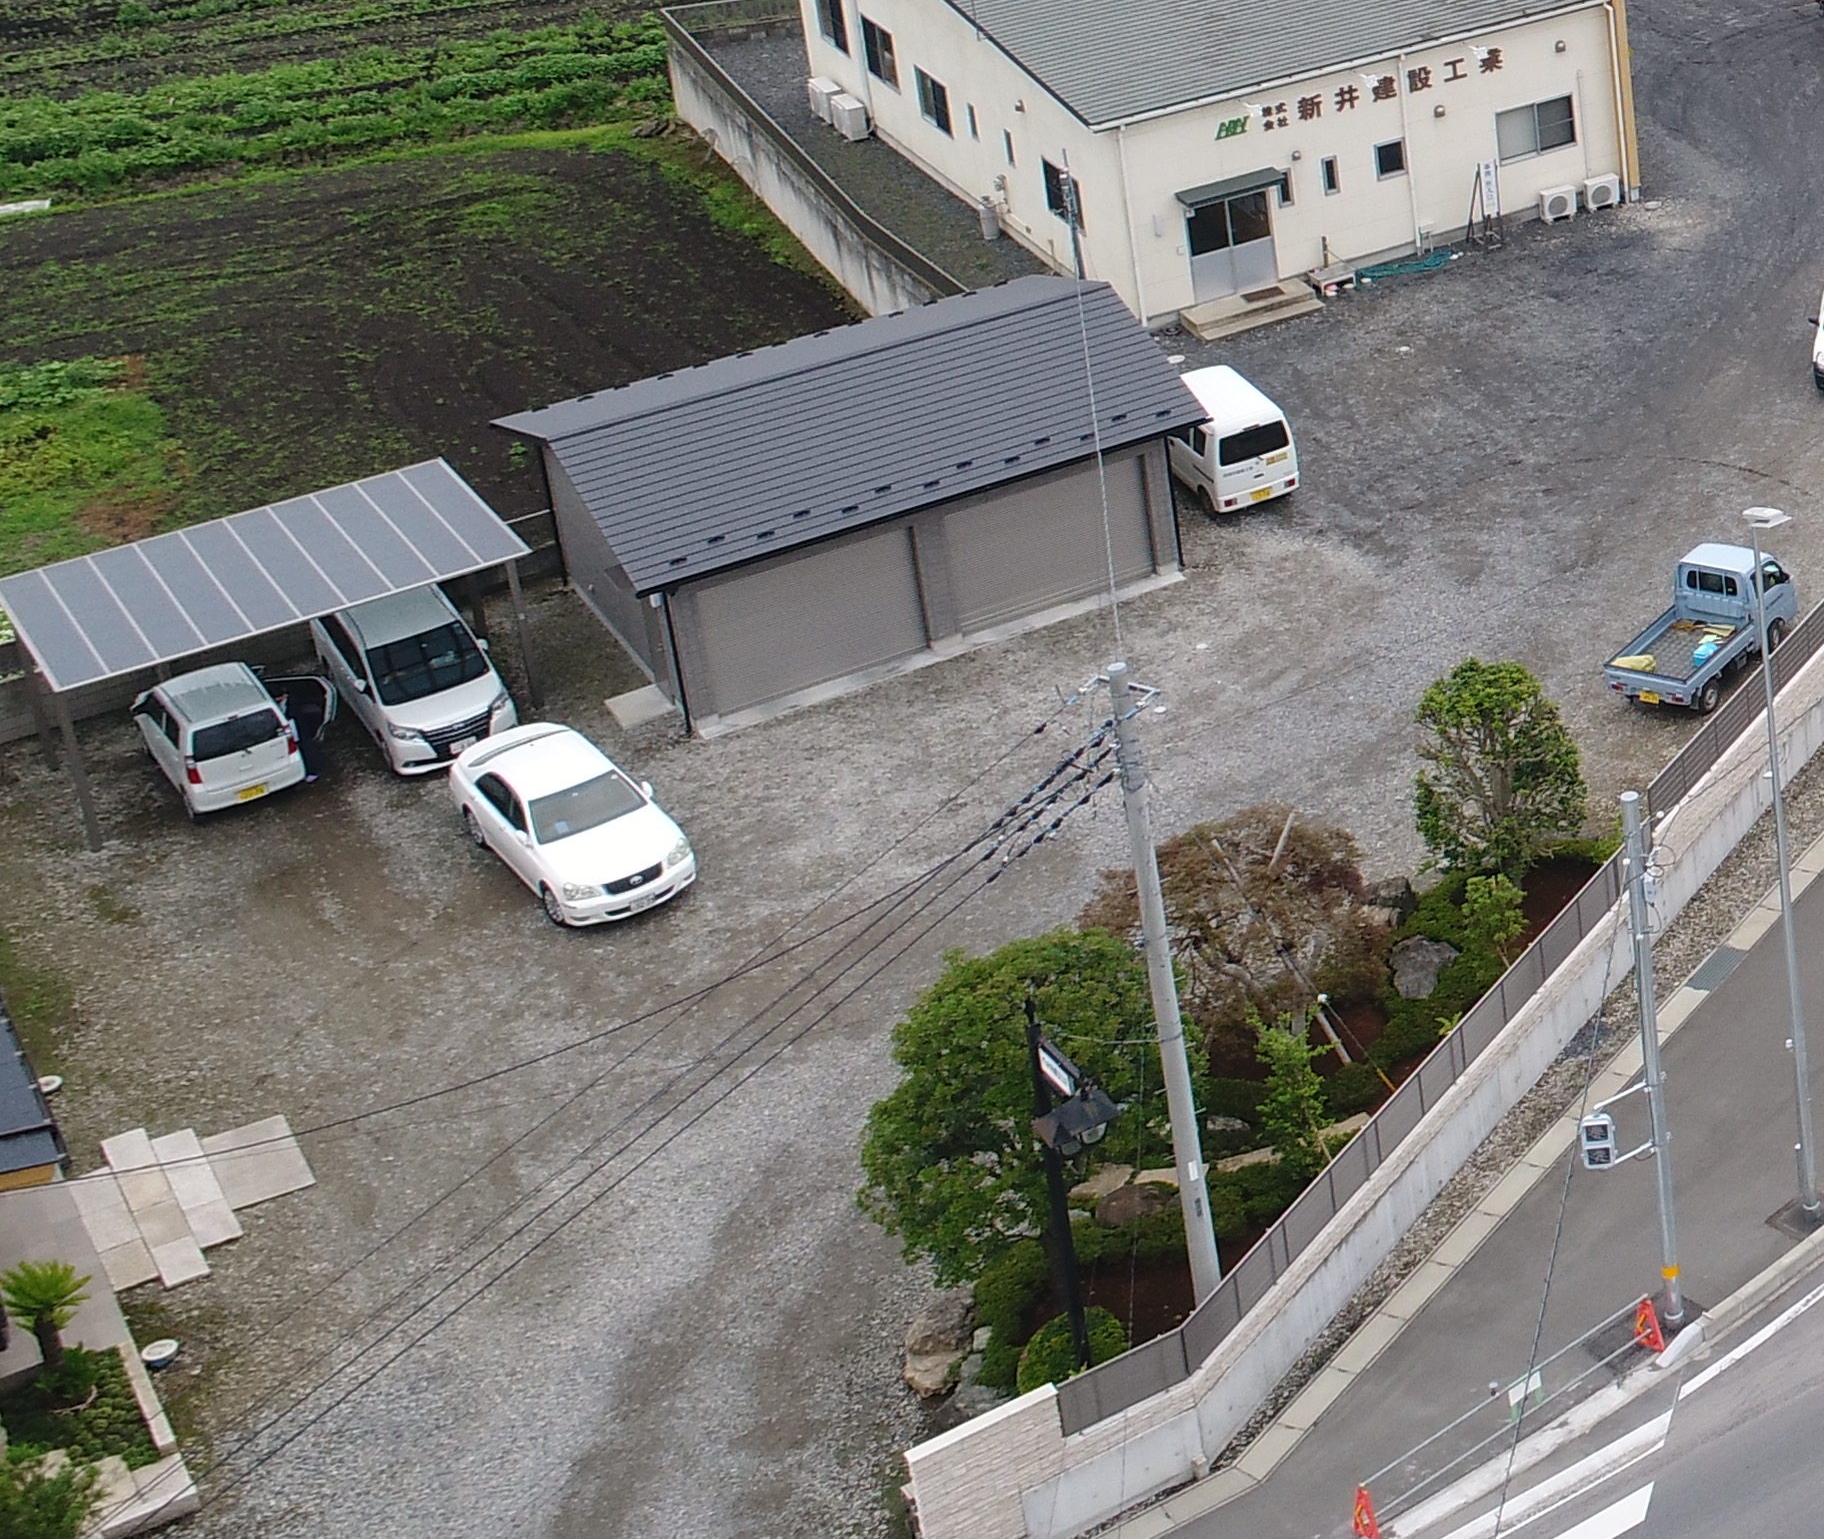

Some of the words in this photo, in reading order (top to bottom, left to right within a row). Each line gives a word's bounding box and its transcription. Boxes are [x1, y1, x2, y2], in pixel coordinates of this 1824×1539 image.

[1297, 47, 1504, 121] 新井建設工業
